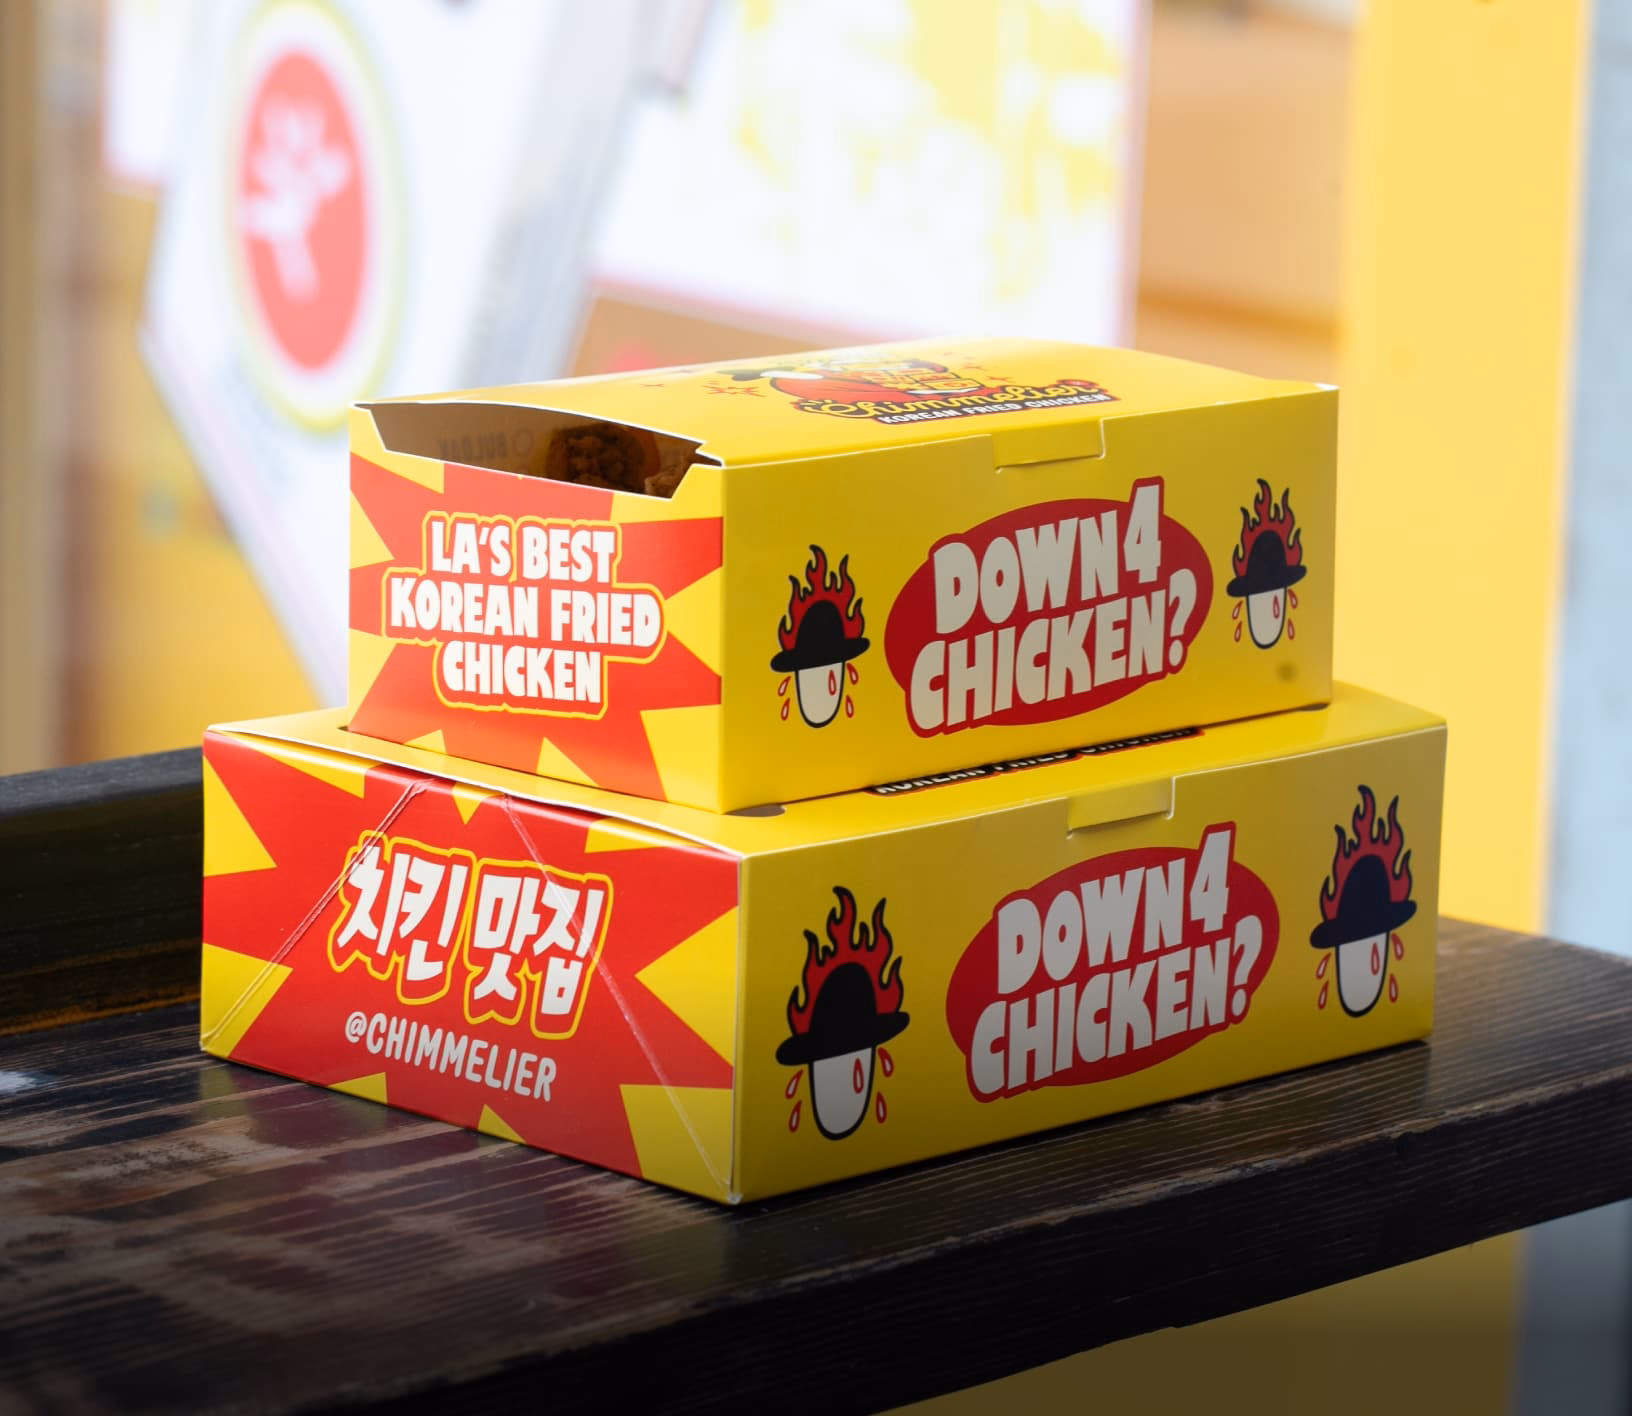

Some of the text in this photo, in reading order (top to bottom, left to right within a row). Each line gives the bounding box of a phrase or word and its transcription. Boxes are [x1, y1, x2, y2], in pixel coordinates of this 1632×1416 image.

[801, 384, 1099, 419] Chimmelier
[877, 393, 1112, 424] KOREAN FRIED CHICKEN
[431, 520, 615, 583] LA'S BEST
[933, 484, 1162, 635] DOWN 4
[390, 577, 662, 648] KOREAN FRIED
[910, 568, 1197, 730] CHICKEN?
[442, 640, 601, 704] CHICKEN
[336, 845, 605, 1015] 치킨 맛집
[997, 829, 1232, 995] DOWN 4
[971, 915, 1263, 1095] CHICKEN?
[344, 1010, 558, 1102] @CHIMMELIER
